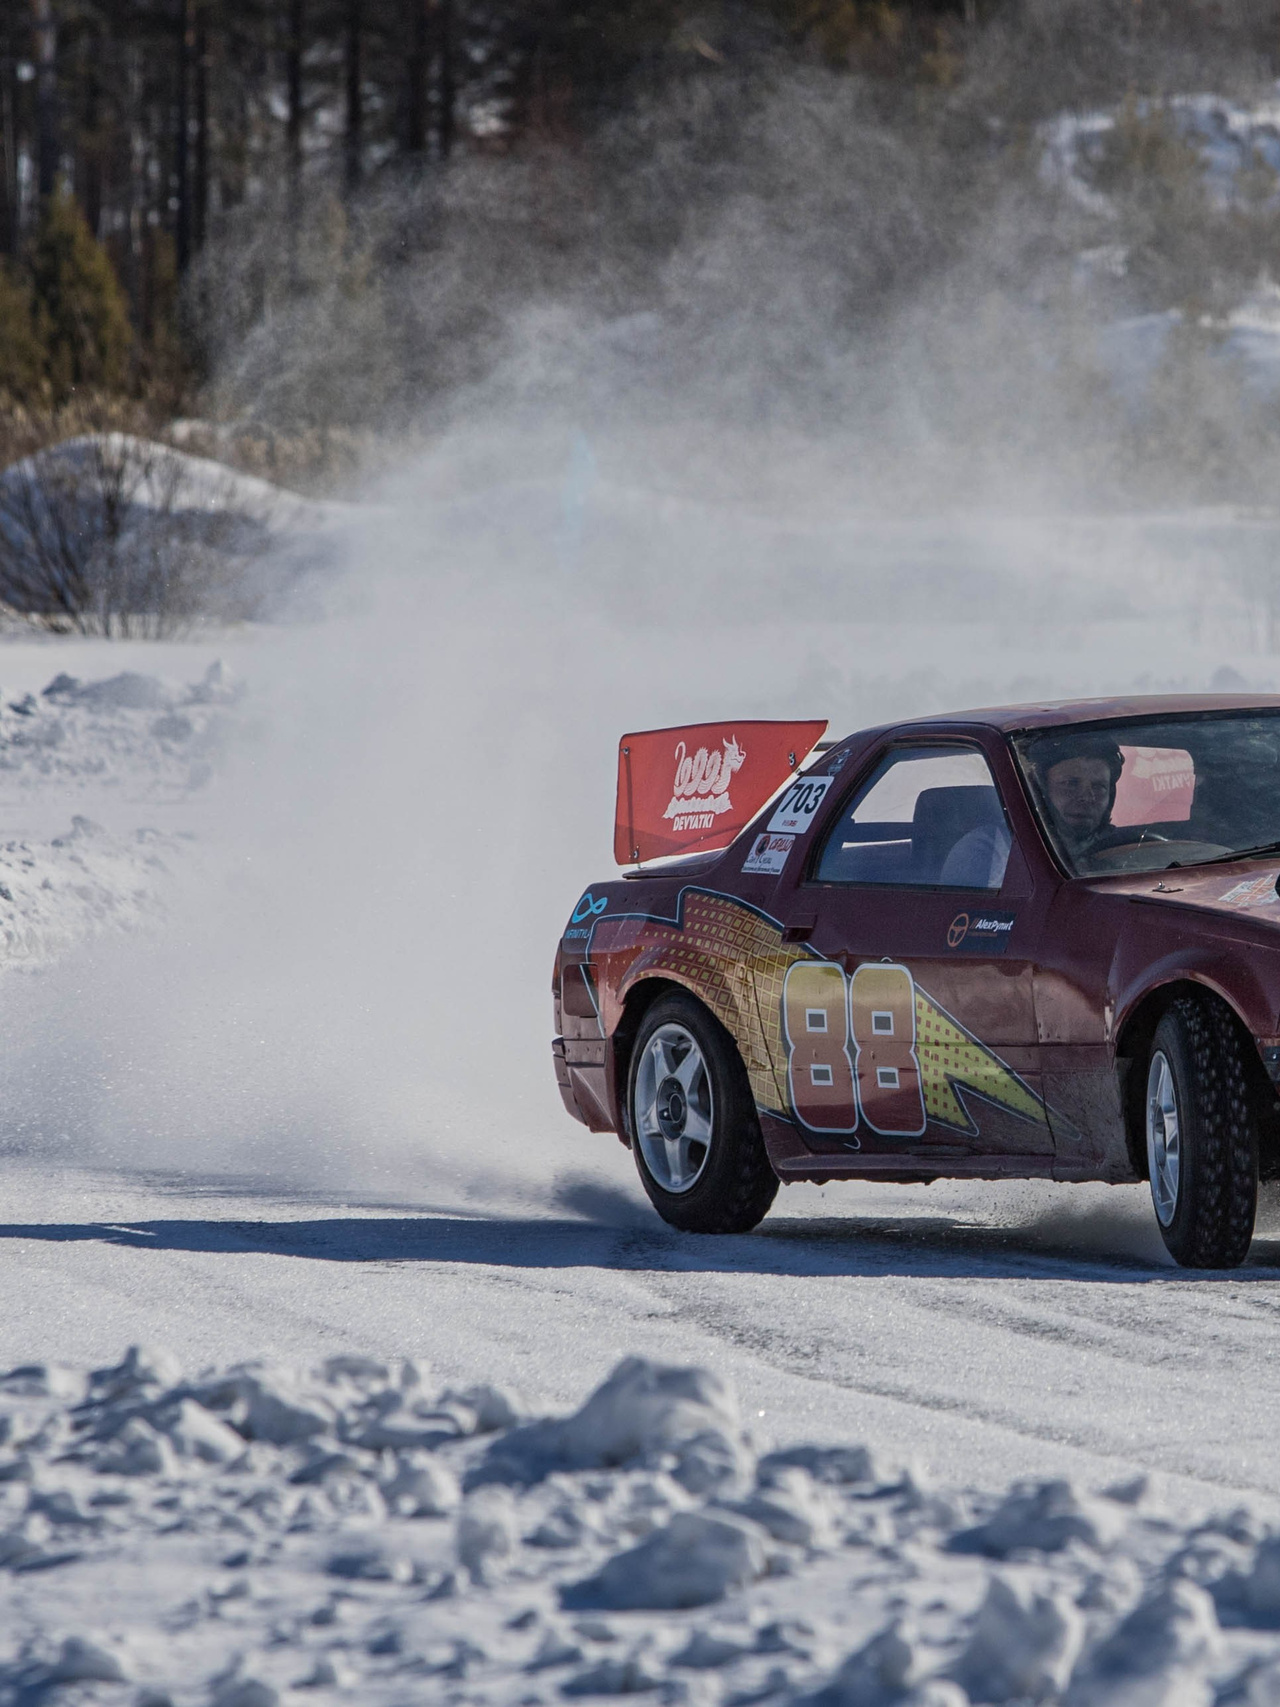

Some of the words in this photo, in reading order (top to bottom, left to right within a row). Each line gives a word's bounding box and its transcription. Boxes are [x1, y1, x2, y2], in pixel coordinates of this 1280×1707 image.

[779, 783, 826, 814] 703
[672, 813, 715, 831] DEVYATKI
[782, 960, 927, 1137] 88
